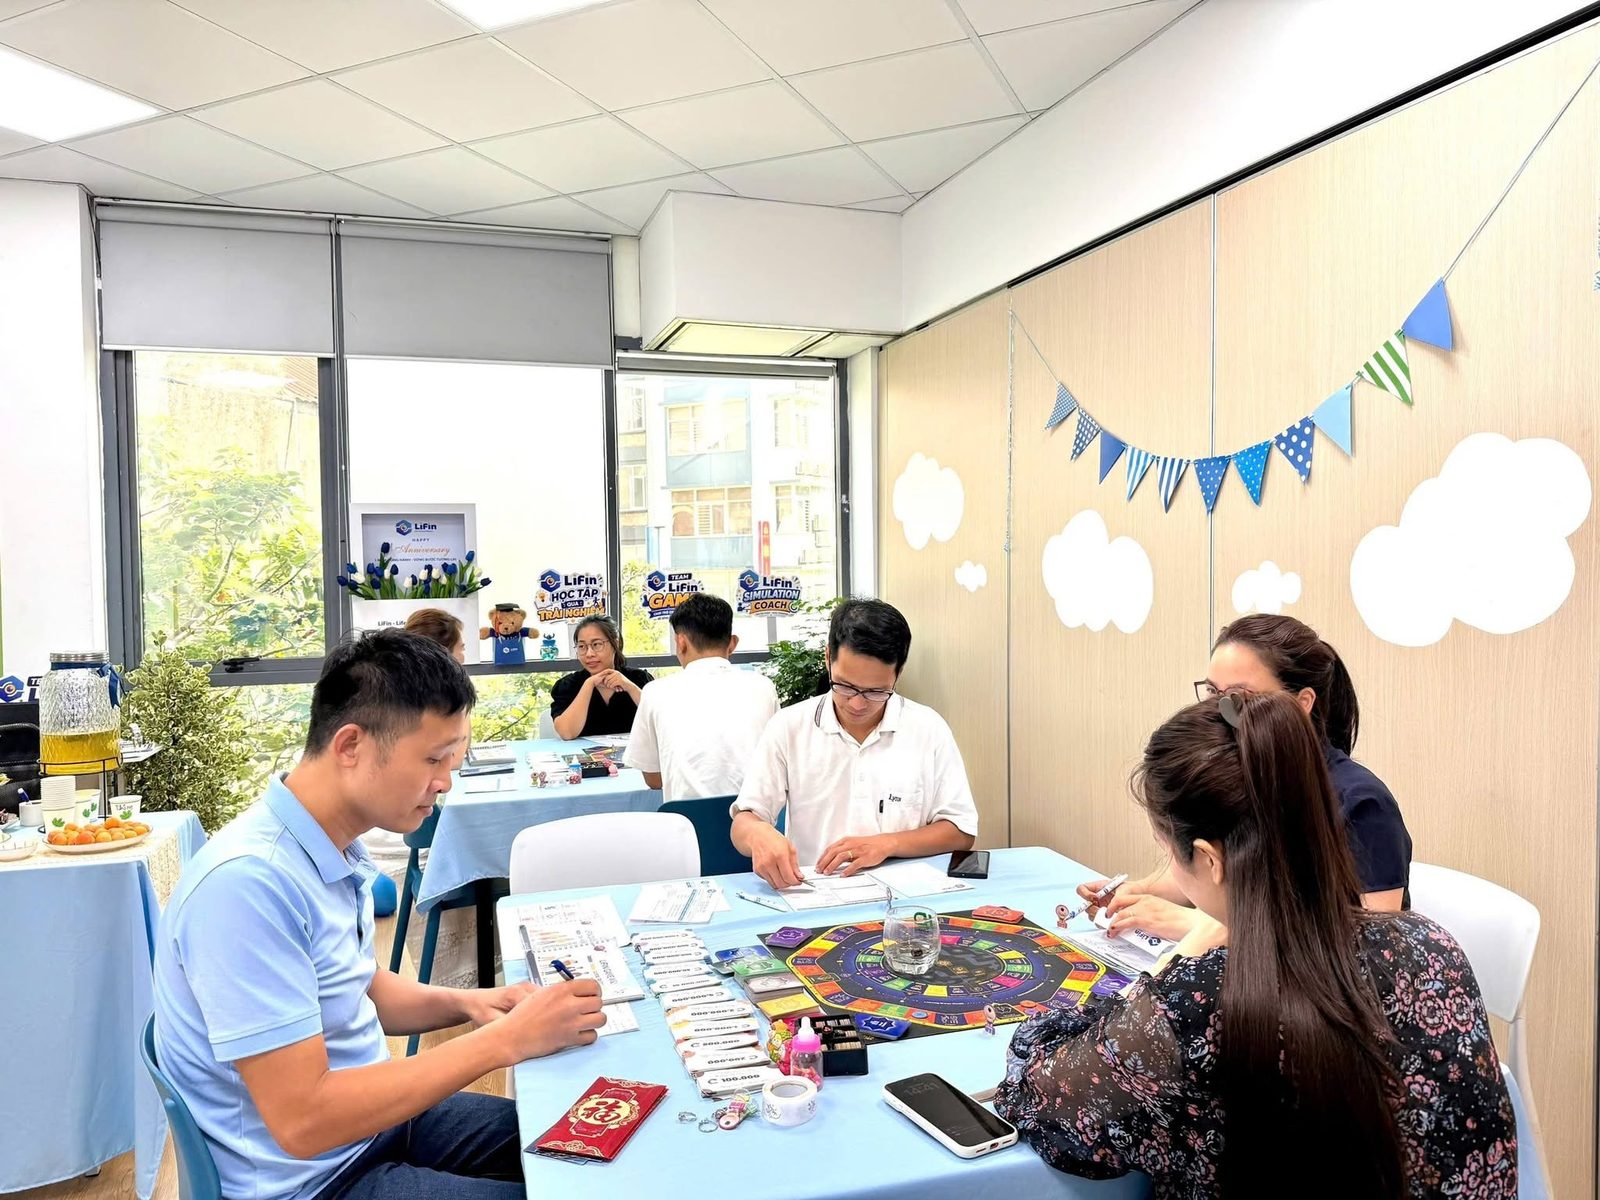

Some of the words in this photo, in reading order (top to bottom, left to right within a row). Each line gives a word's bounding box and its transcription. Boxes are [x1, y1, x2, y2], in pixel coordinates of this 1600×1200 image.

[394, 543, 450, 556] Anniversary
[564, 573, 597, 586] LiFin
[763, 576, 793, 588] LiFin
[668, 582, 698, 592] LiFin
[551, 589, 575, 603] HỌC
[577, 586, 599, 600] TẬP
[743, 589, 800, 602] SIMULATION
[648, 592, 699, 610] GAM
[754, 601, 788, 610] COACH
[1134, 929, 1149, 941] LiFin
[721, 1073, 760, 1083] 100.000
